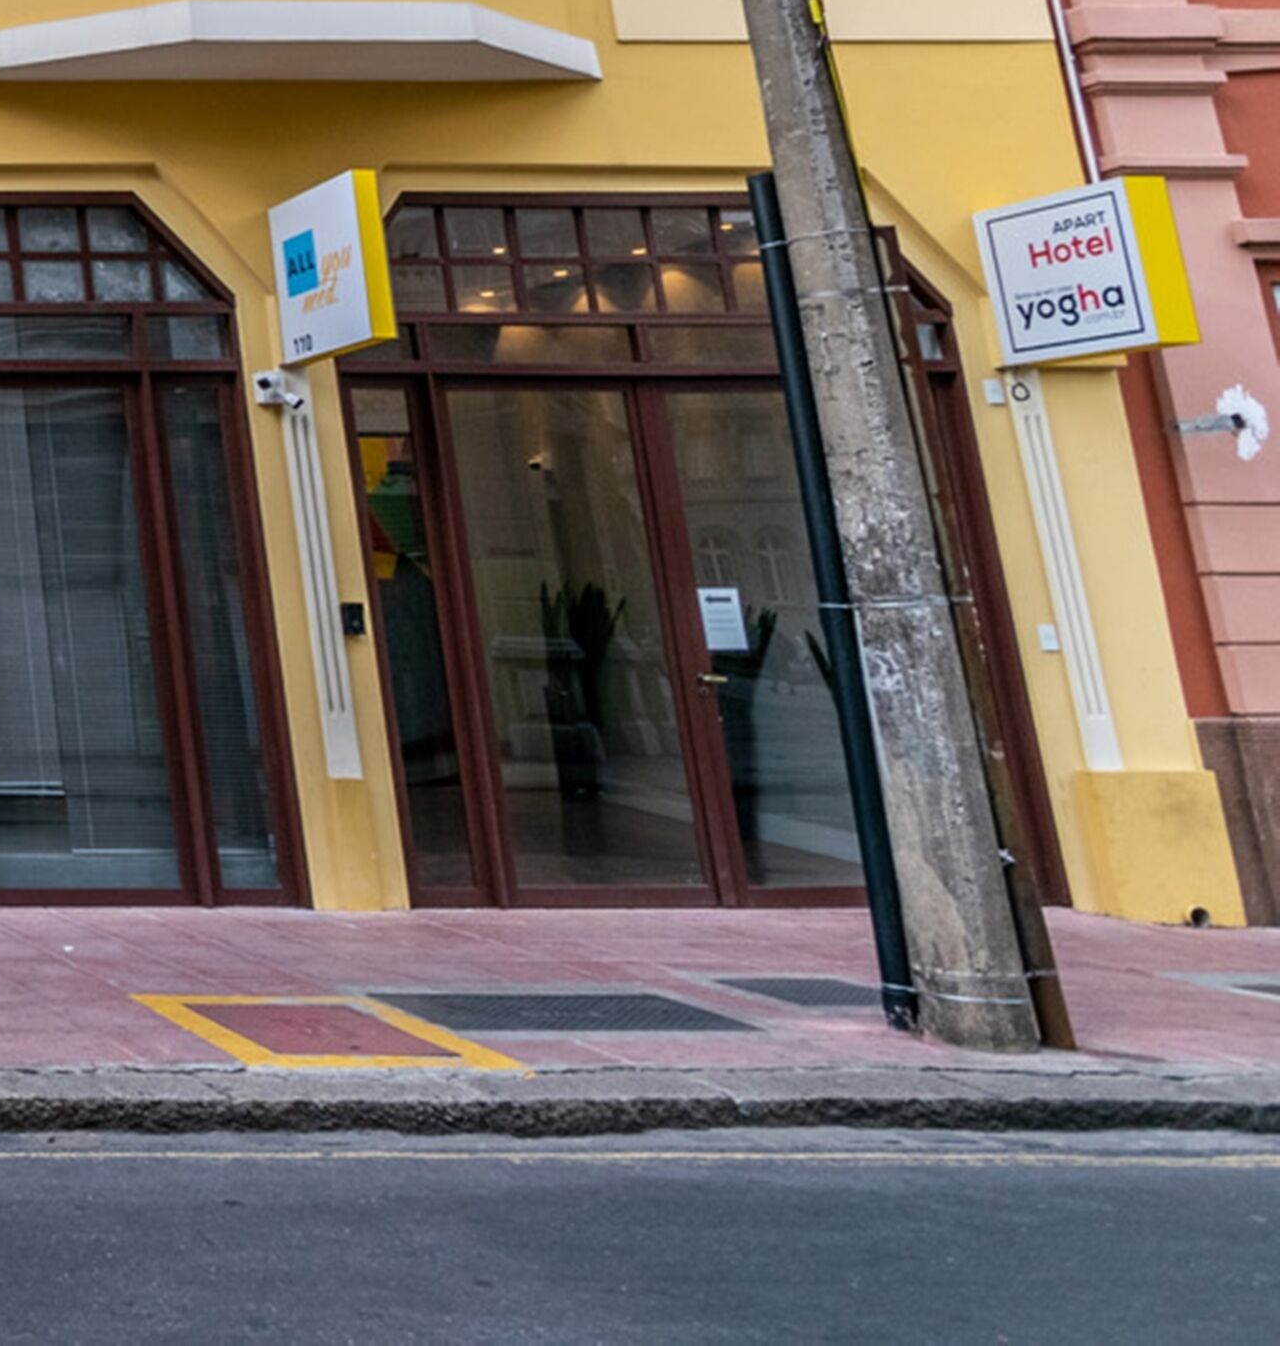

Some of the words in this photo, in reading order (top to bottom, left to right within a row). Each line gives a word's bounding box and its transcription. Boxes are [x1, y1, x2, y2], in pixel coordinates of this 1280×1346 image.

[1051, 210, 1106, 234] APART
[288, 250, 315, 278] ALL
[1027, 226, 1114, 269] Hotel
[1015, 282, 1126, 330] yogha
